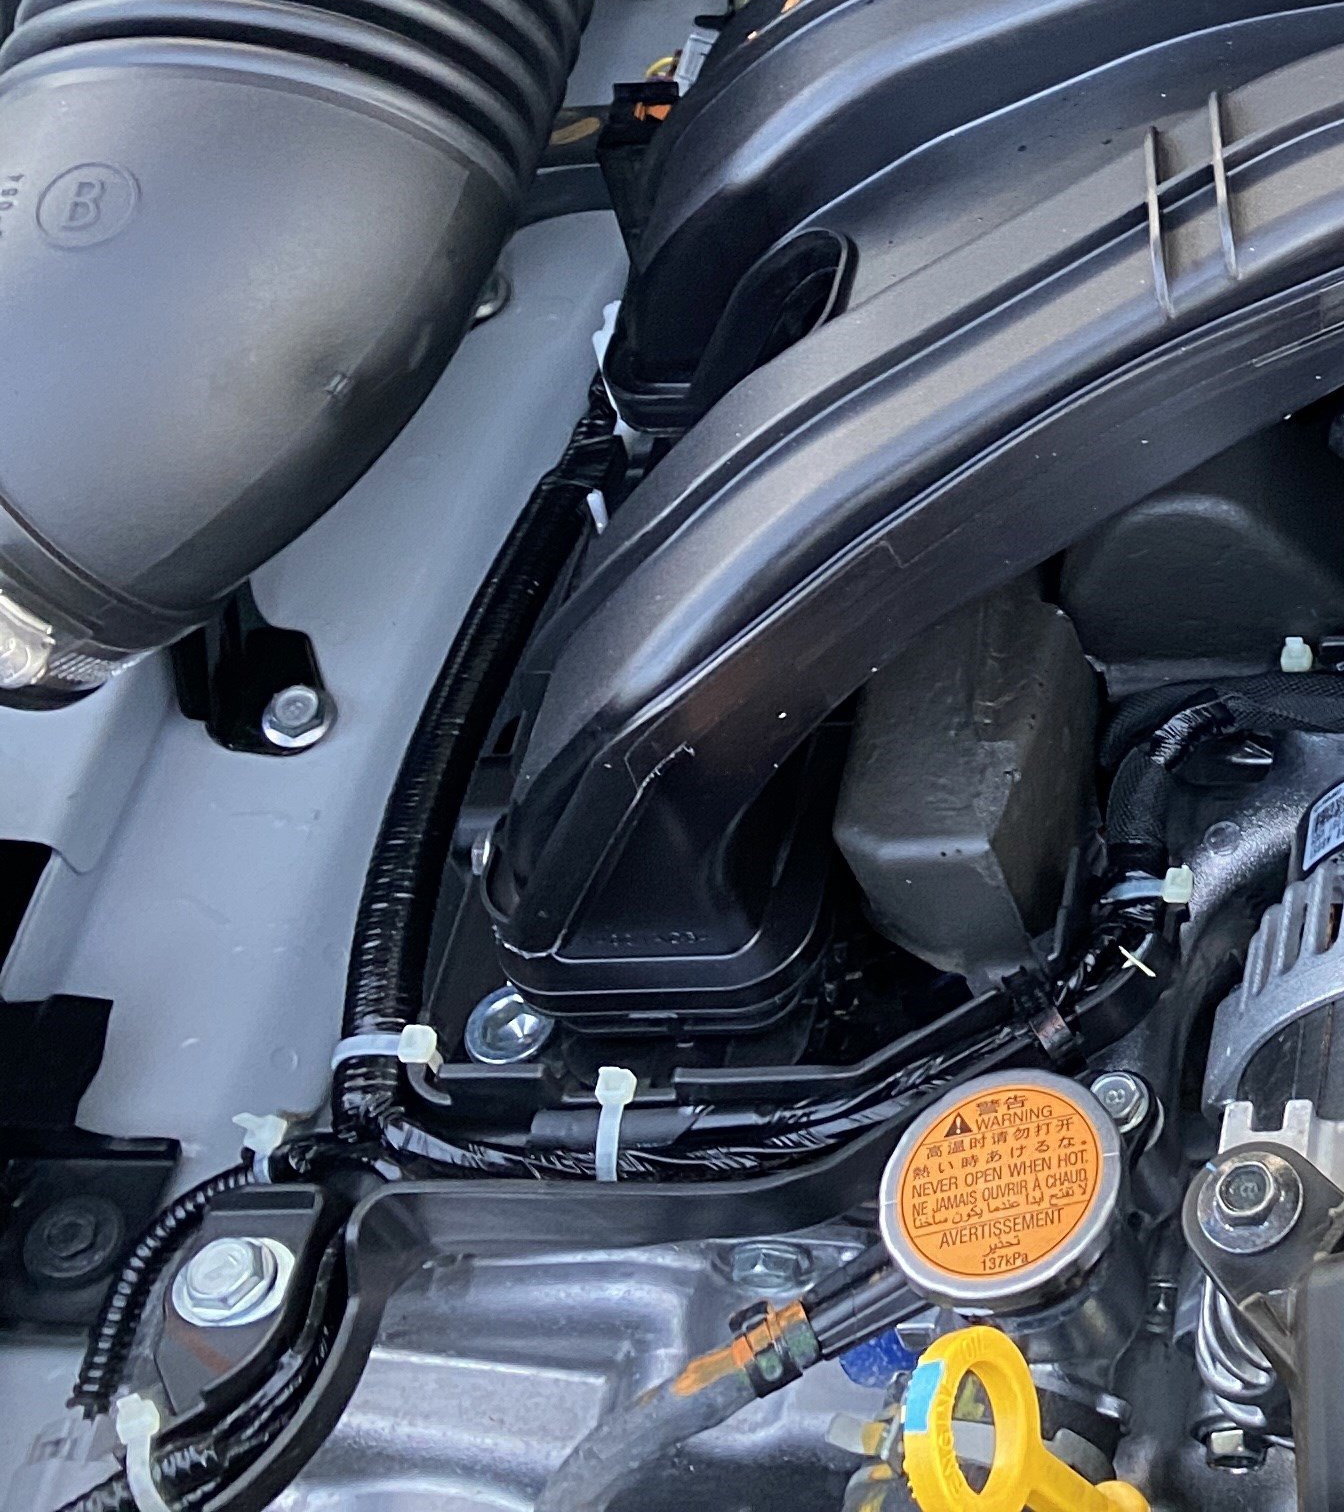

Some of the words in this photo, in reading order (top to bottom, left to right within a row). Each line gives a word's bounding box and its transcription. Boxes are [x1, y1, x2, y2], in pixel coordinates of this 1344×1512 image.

[975, 1105, 1053, 1132] WARNING
[912, 1174, 958, 1199] NEVER
[965, 1167, 1002, 1188] OPEN
[1008, 1157, 1052, 1178] WHEN
[913, 1198, 928, 1217] NE
[933, 1191, 978, 1213] JAMAIS
[982, 1181, 1028, 1202] OUVRIR
[1032, 1175, 1042, 1192] À
[939, 1207, 1065, 1249] AVERTISSEMENT
[980, 1253, 1029, 1272] 137kPa
